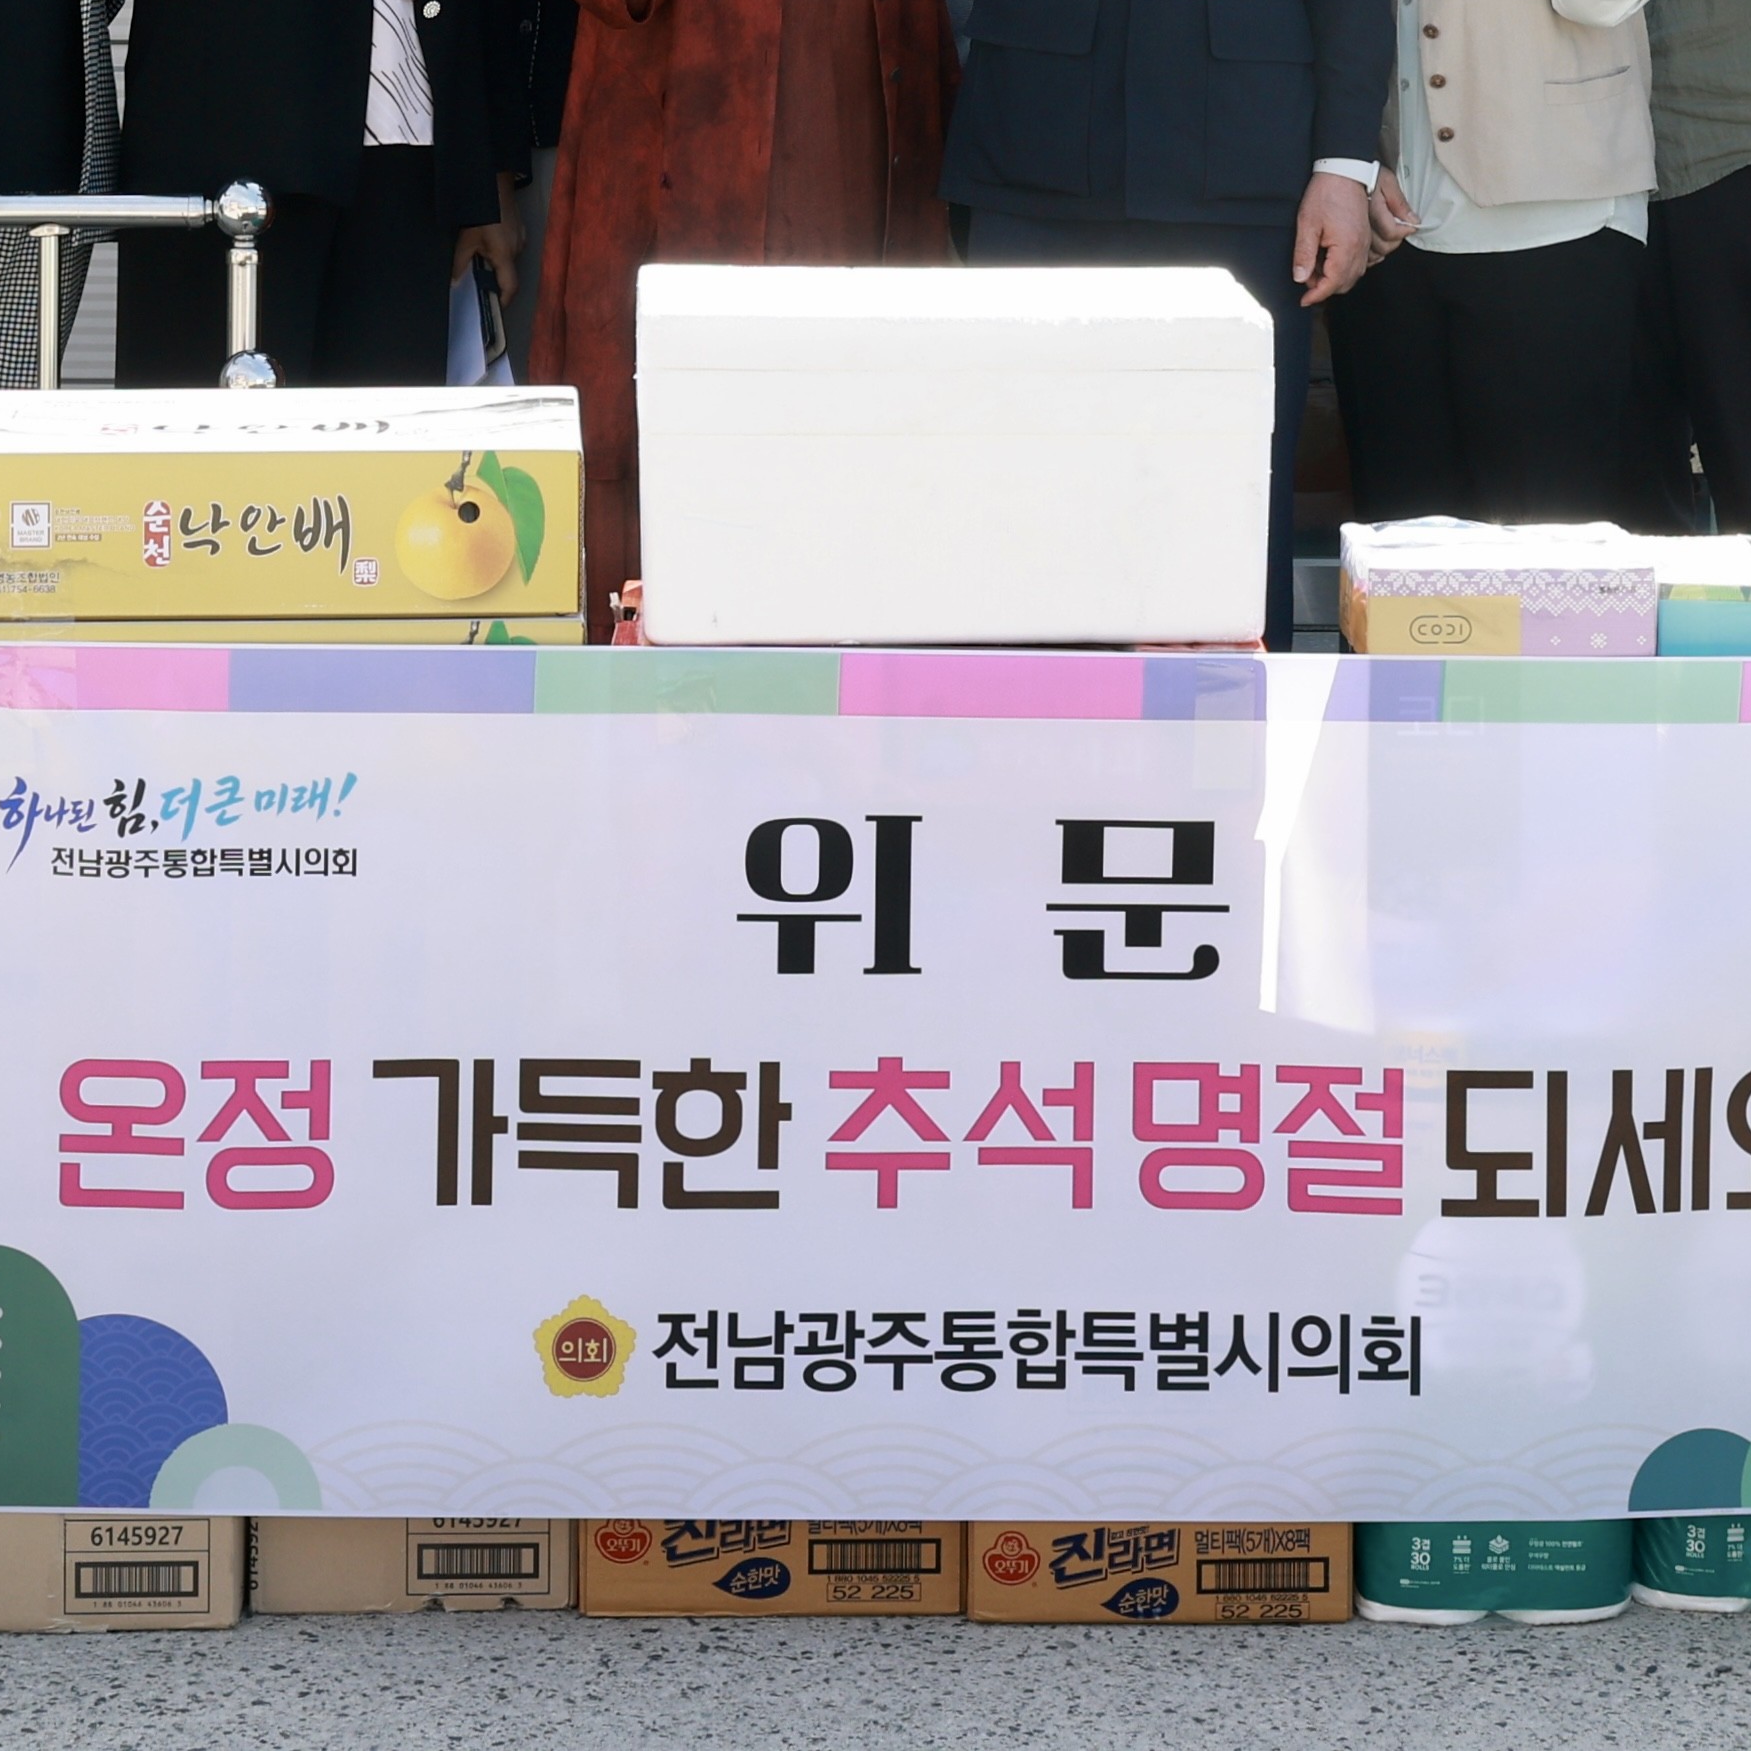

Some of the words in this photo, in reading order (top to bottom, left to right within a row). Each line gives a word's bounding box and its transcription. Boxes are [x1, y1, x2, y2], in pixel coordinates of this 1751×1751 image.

[144, 501, 171, 565] 순천
[179, 495, 351, 575] 낙안배
[103, 778, 160, 839] 힘,
[160, 778, 203, 844] 더
[205, 775, 246, 827] 큰
[254, 771, 359, 823] 미래!
[50, 847, 359, 880] 전남광주통합특별시의회
[56, 1056, 333, 1211] 온정
[370, 1056, 794, 1211] 가득한
[822, 1056, 1100, 1211] 추석
[1128, 1056, 1408, 1211] 명절
[559, 1337, 608, 1363] 의회
[649, 1306, 1428, 1398] 전남광주통합특별시의회
[91, 1526, 184, 1547] 6145927
[605, 1536, 641, 1553] 오뚜기
[1194, 1527, 1311, 1556] 멀티팩(5개)X8팩
[1411, 1536, 1431, 1551] 3겹
[1686, 1524, 1706, 1540] 3겹
[1049, 1526, 1181, 1590] 진라면
[1410, 1551, 1431, 1566] 30
[1685, 1539, 1706, 1553] 30
[994, 1558, 1030, 1575] 오뚜기
[729, 1566, 782, 1594] 순한맛
[833, 1584, 862, 1600] 52
[871, 1584, 914, 1600] 225
[1119, 1583, 1170, 1614] 순한맛
[1220, 1603, 1250, 1619] 52
[1259, 1603, 1304, 1619] 225
